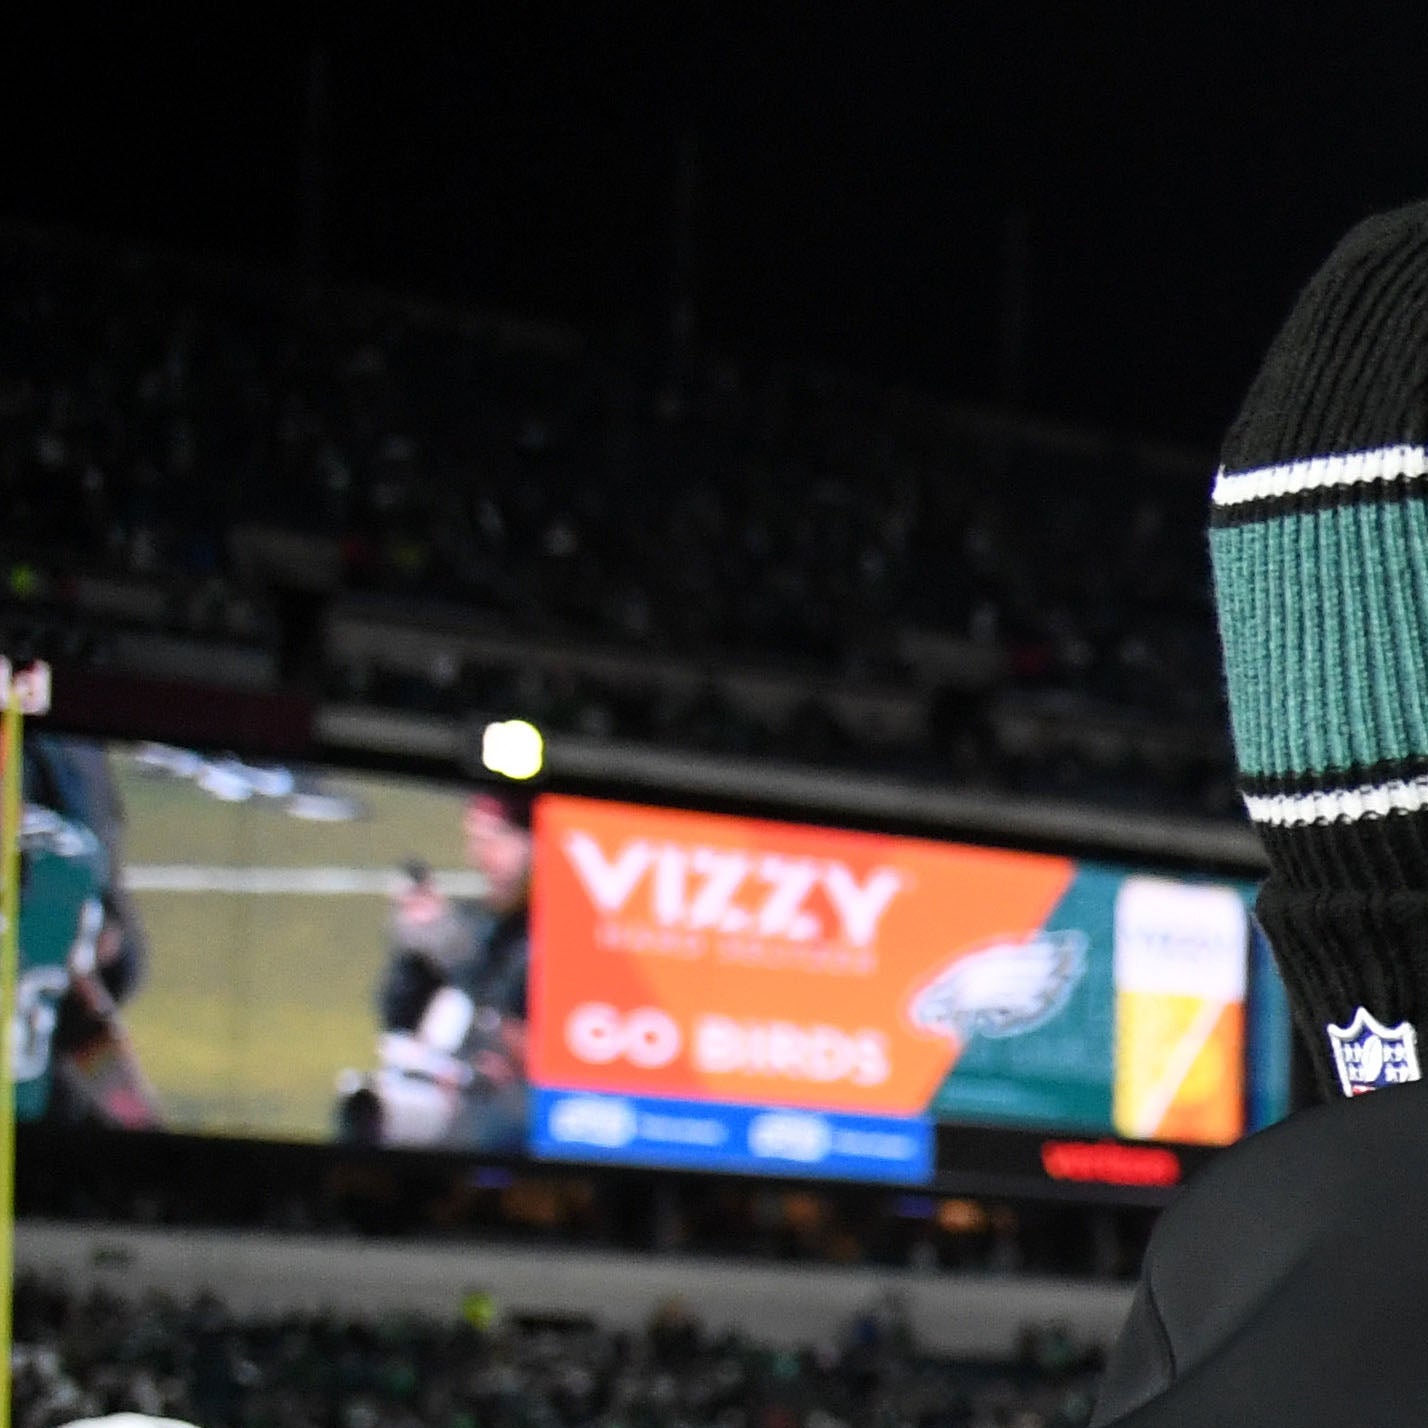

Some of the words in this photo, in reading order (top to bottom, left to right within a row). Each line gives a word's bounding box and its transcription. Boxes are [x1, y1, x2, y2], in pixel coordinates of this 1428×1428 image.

[563, 831, 905, 946] VIZZY
[565, 1001, 682, 1069] GO
[691, 1014, 891, 1086] BIRDS
